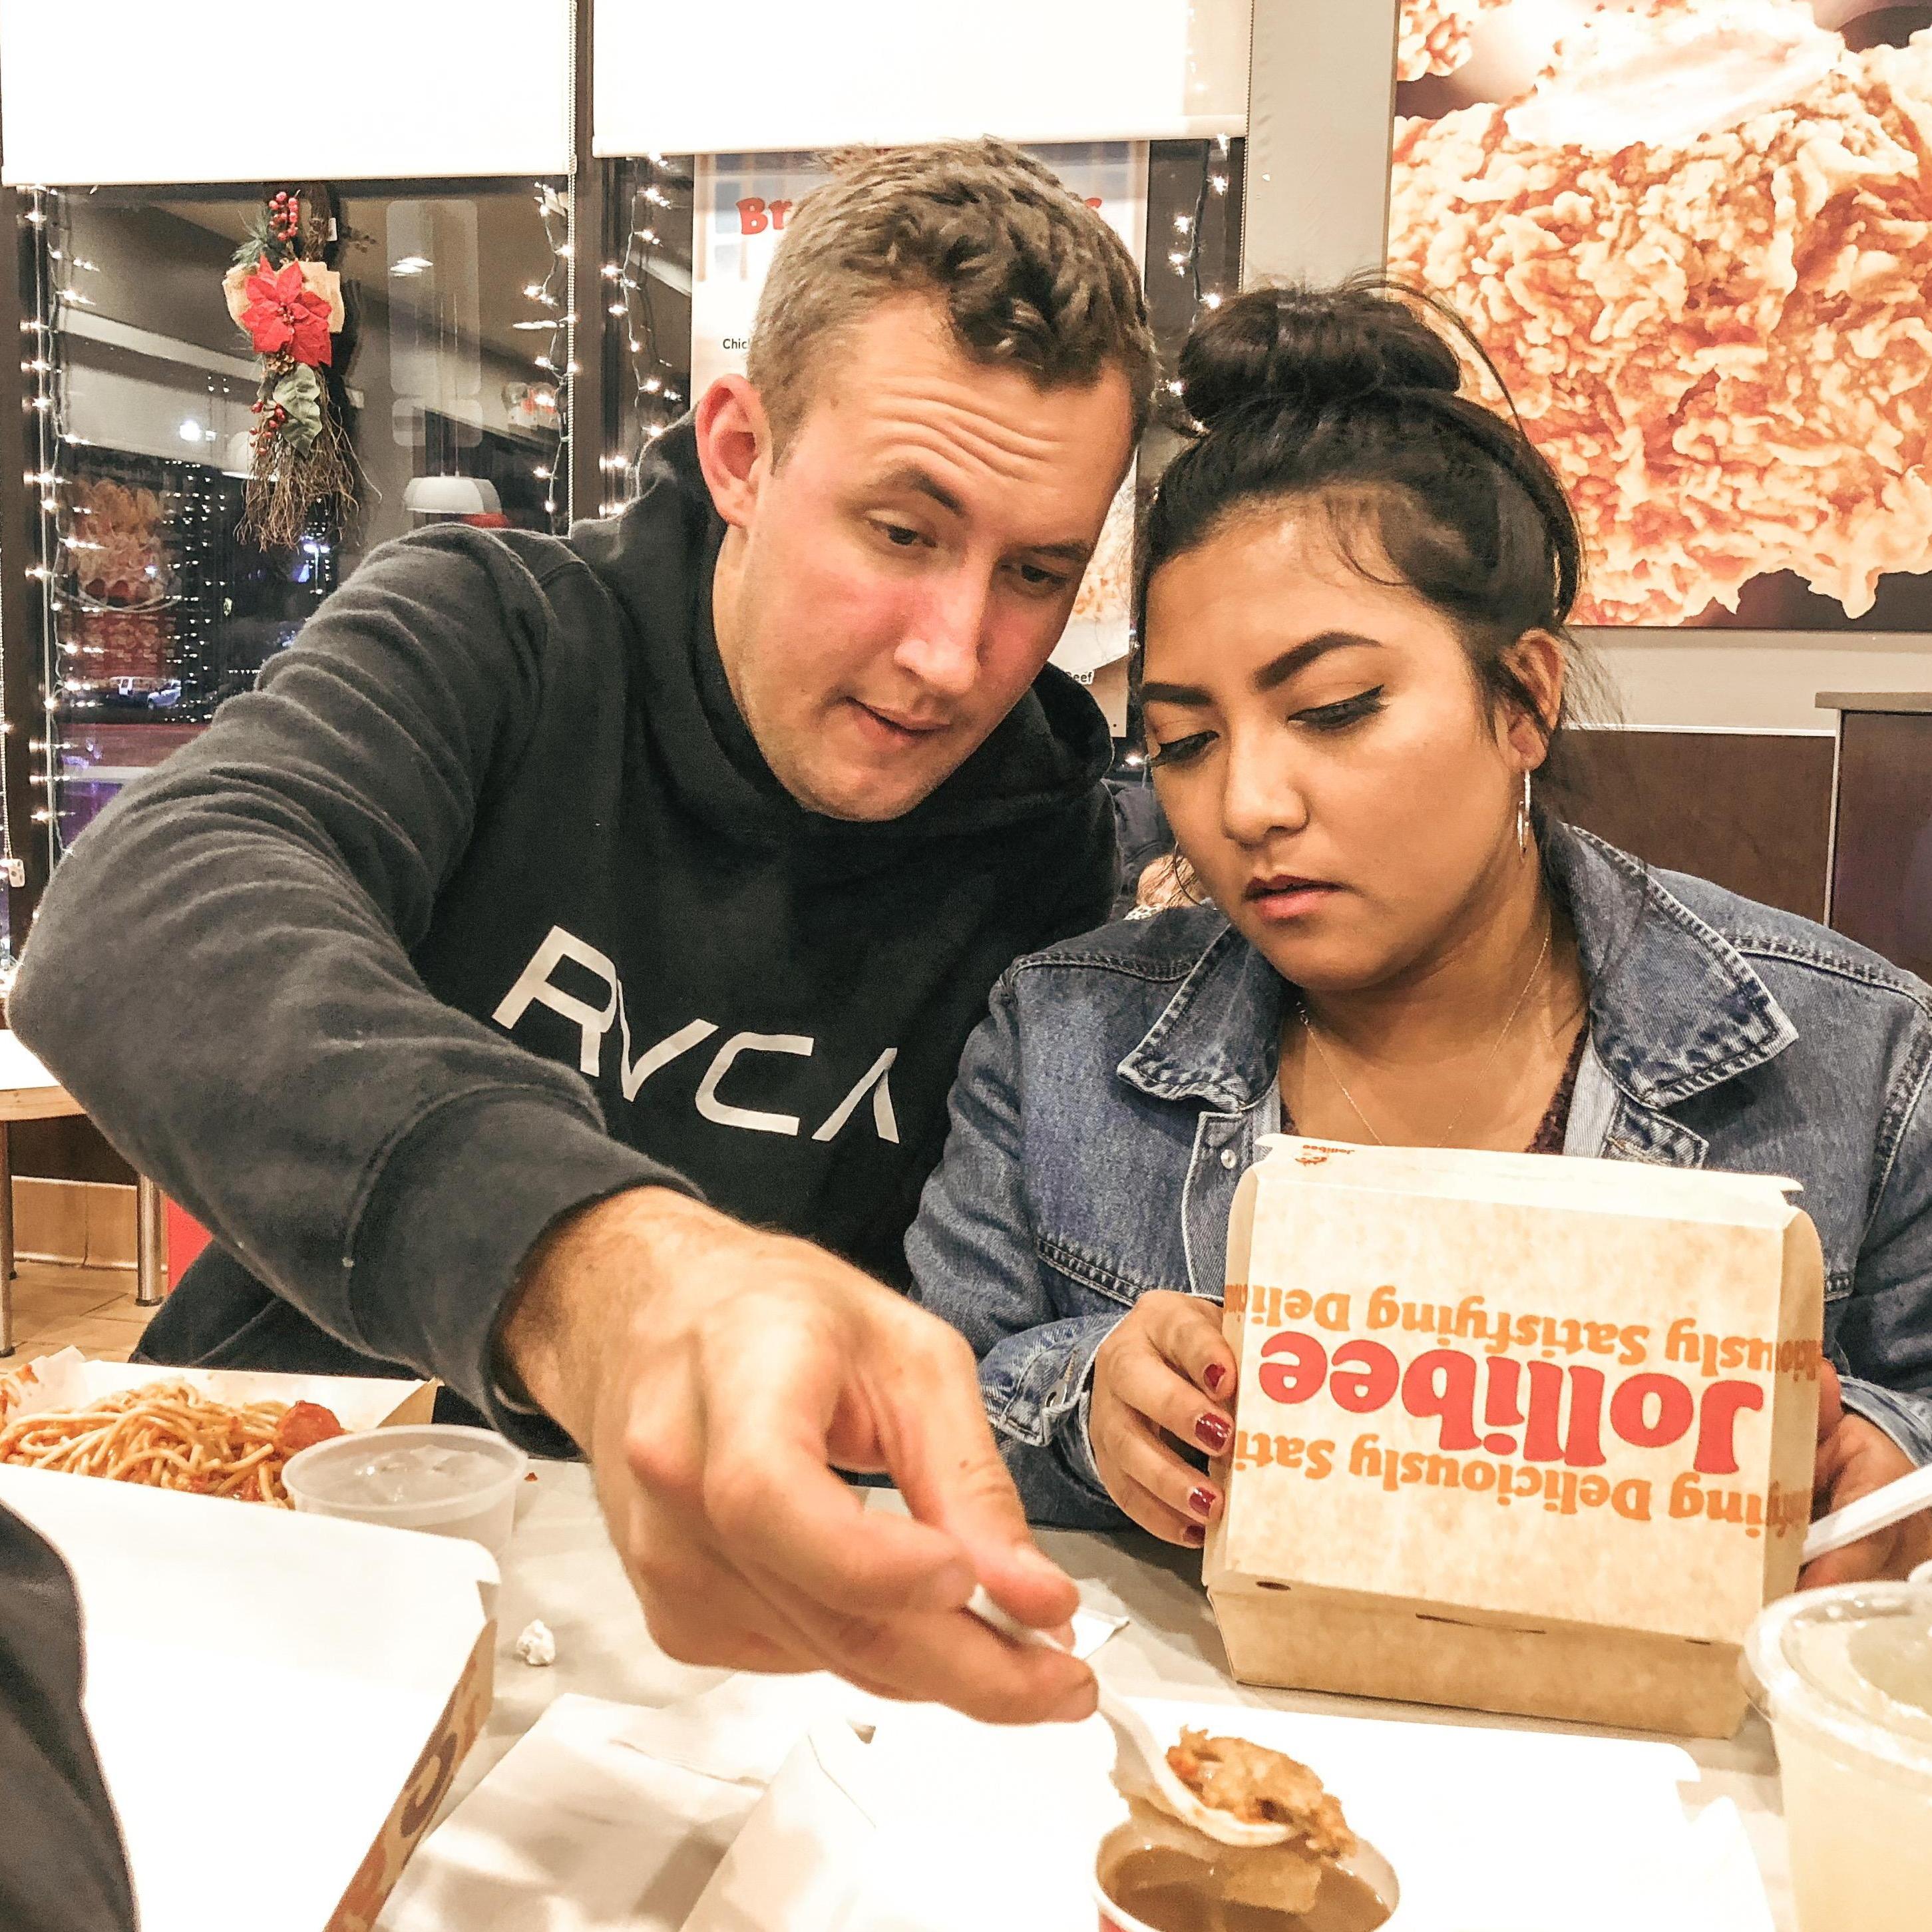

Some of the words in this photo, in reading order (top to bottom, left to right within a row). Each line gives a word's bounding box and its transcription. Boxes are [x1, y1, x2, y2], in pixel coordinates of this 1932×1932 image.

[491, 924, 900, 1145] RVCA
[1366, 1284, 1650, 1366] Satisfying
[1258, 1330, 1764, 1475] Jollibee
[1348, 1432, 1652, 1522] Deliciously
